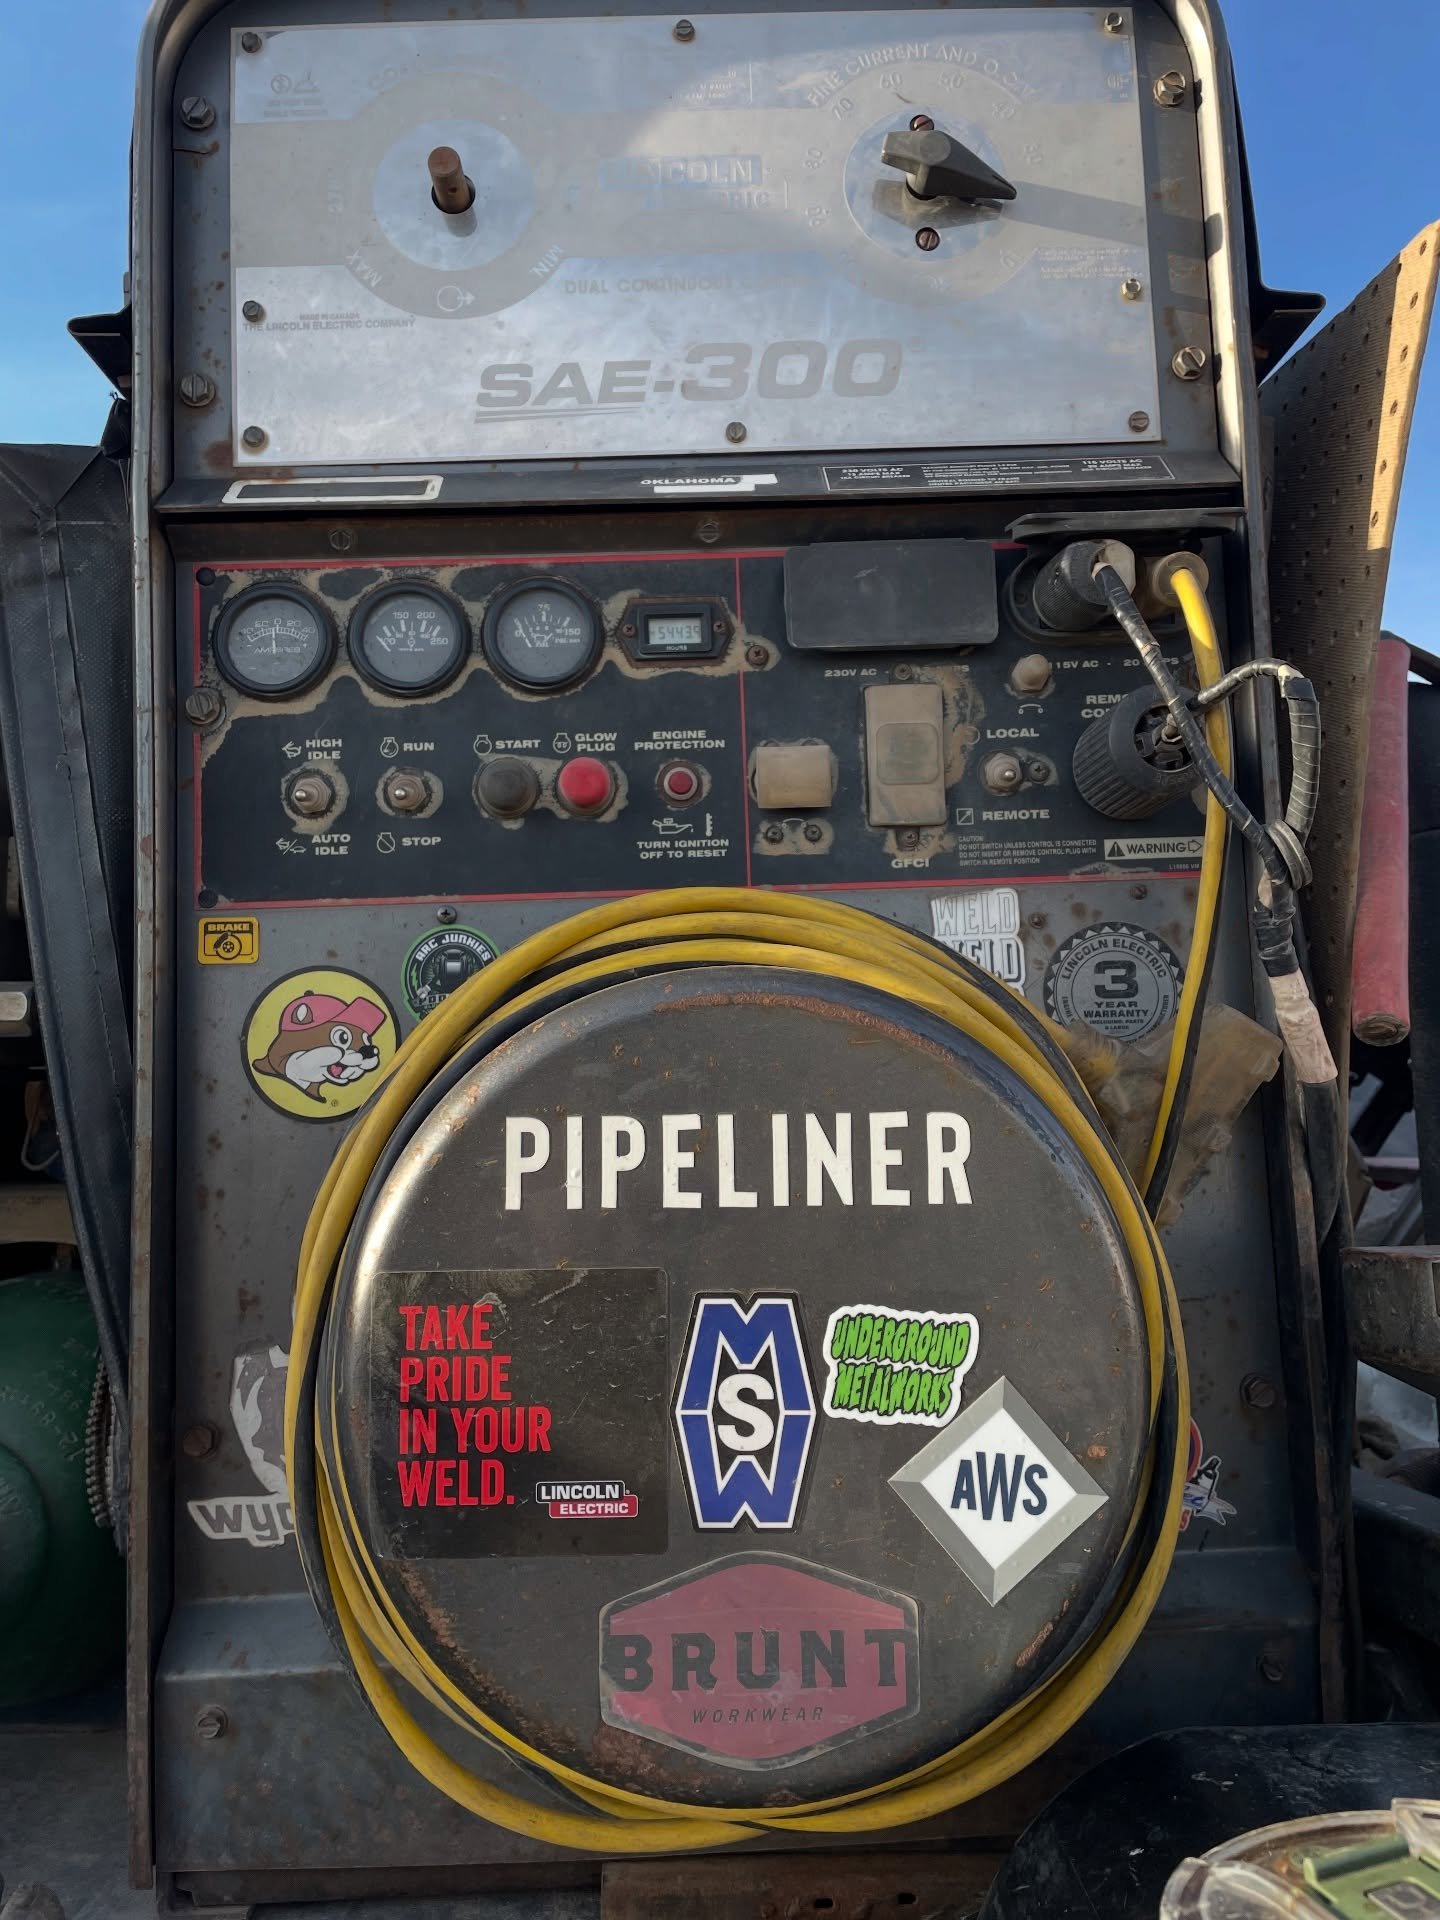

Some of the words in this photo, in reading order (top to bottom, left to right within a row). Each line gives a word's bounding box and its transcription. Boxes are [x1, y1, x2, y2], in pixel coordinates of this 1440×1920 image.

[807, 69, 847, 107] FINE
[846, 44, 928, 77] CURRENT
[936, 45, 977, 66] AND
[565, 279, 608, 294] DUAL
[243, 322, 263, 333] THE
[266, 321, 310, 332] LINCOLN
[312, 319, 362, 330] ELECTRIC
[365, 317, 416, 329] COMPANY
[475, 338, 903, 409] SAE-300
[640, 477, 737, 485] OKLAHOMA
[392, 611, 409, 620] 150
[416, 611, 436, 620] 200
[301, 626, 316, 634] 40
[564, 627, 581, 636] 150
[430, 637, 449, 646] 250
[1082, 660, 1099, 668] AC
[1123, 658, 1140, 667] 20
[824, 669, 857, 677] 230V
[860, 668, 878, 676] AC
[575, 732, 617, 743] GLOW
[652, 730, 707, 740] ENGINE
[986, 727, 1040, 739] LOCAL
[306, 738, 343, 749] HIGH
[403, 742, 435, 752] RUN
[495, 739, 541, 750] START
[576, 742, 616, 752] PLUG
[634, 739, 726, 751] PROTECTION
[308, 750, 341, 760] IDLE
[982, 808, 1050, 821] REMOTE
[312, 833, 351, 844] AUTO
[402, 836, 442, 846] STOP
[637, 840, 671, 849] TURN
[674, 839, 730, 848] IGNITION
[1062, 839, 1097, 847] CONNECTED
[315, 845, 348, 856] IDLE
[1038, 848, 1065, 856] CONTROL
[1126, 841, 1187, 856] WARNING
[639, 851, 664, 860] OFF
[667, 850, 684, 859] TO
[687, 849, 727, 858] RESET
[891, 858, 929, 869] GFCI
[959, 859, 981, 867] SWITCH
[1013, 857, 1040, 865] POSITION
[933, 891, 1019, 936] WELD
[207, 922, 251, 932] BRAKE
[415, 938, 440, 963] ARC
[441, 932, 493, 962] JUNKIES
[1062, 938, 1109, 980] LINCOLN
[1112, 938, 1168, 979] ELECTRIC
[1094, 960, 1139, 999] 3
[1094, 1001, 1139, 1009] YEAR
[1083, 1009, 1149, 1018] WARRANTY
[505, 1110, 973, 1210] PIPELINER
[399, 1304, 493, 1351] TAKE
[832, 1312, 971, 1369] UNDERGROUND
[399, 1355, 512, 1402] PRIDE
[832, 1362, 955, 1418] METALWORKS
[399, 1408, 437, 1455] IN
[451, 1406, 552, 1453] YOUR
[397, 1459, 515, 1507] WELD.
[950, 1451, 1048, 1522] AWS
[541, 1484, 620, 1500] LINCOLN
[560, 1502, 629, 1515] ELECTRIC
[602, 1628, 906, 1692] BRUNT
[692, 1706, 823, 1724] WORKWEAR
